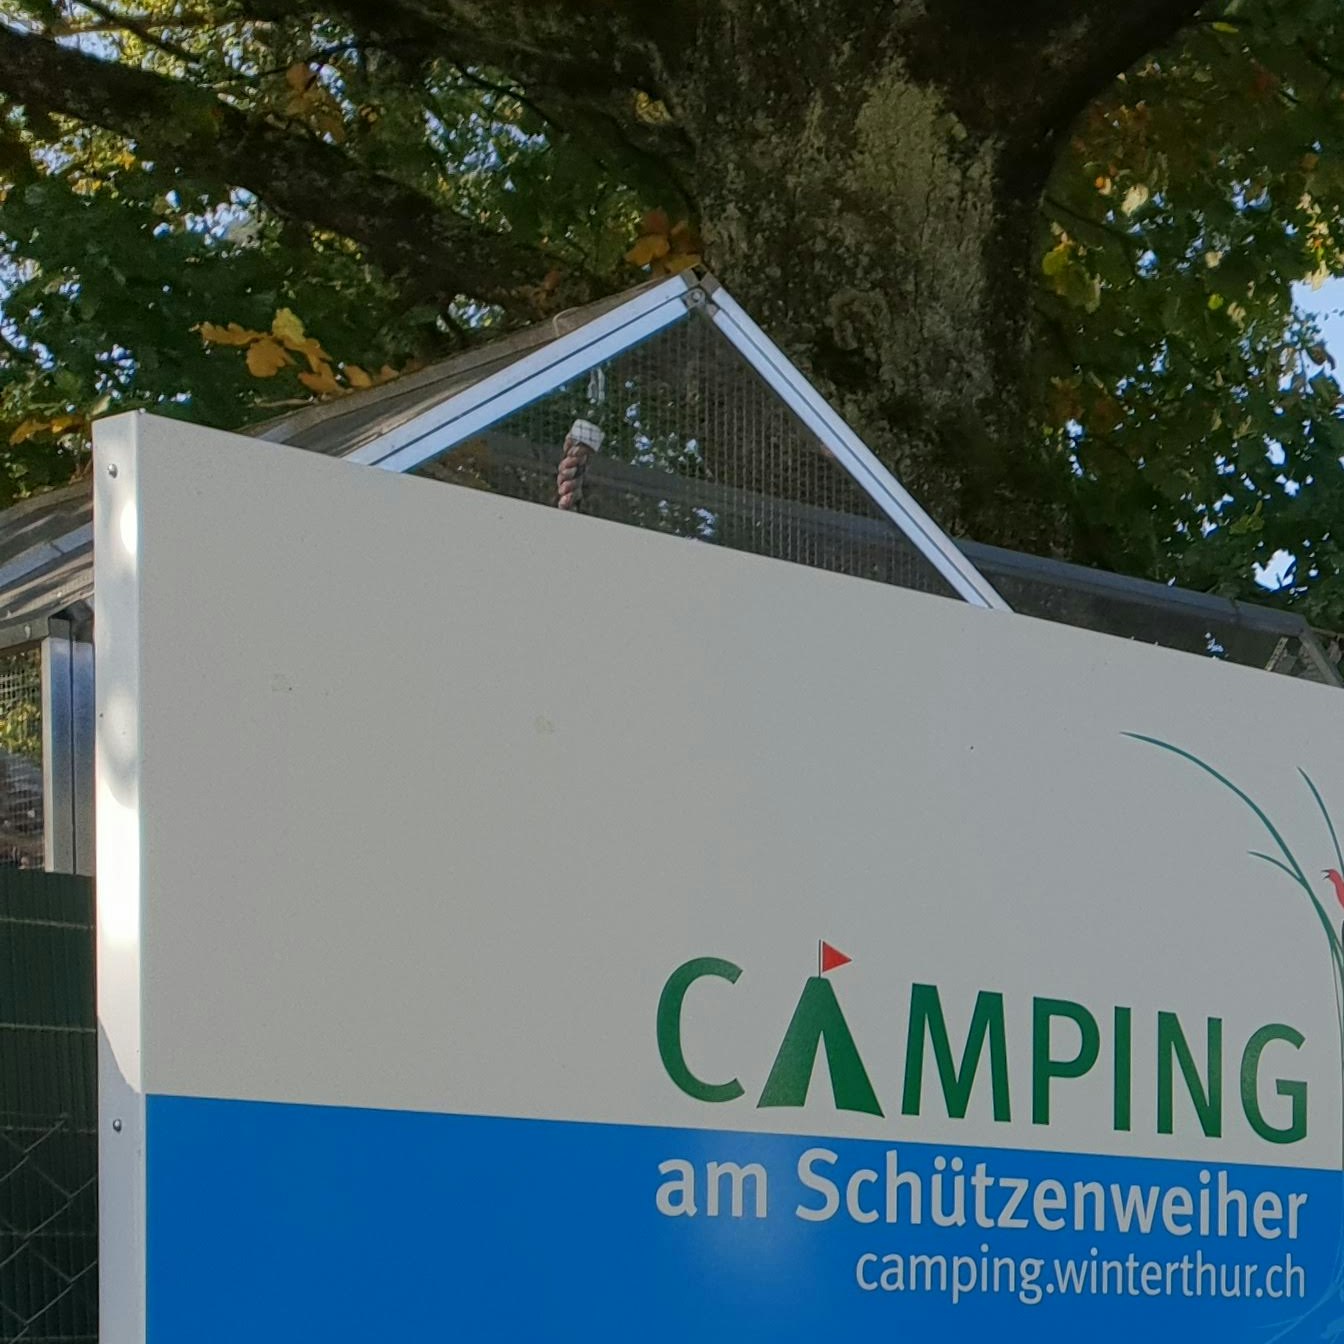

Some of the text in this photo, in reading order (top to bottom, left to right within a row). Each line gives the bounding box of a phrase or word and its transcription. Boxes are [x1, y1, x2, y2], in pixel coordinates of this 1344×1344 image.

[656, 956, 1309, 1144] CAMPING
[655, 1147, 1308, 1240] am Schützenweiher
[855, 1244, 1306, 1305] camping.winterthur.ch
